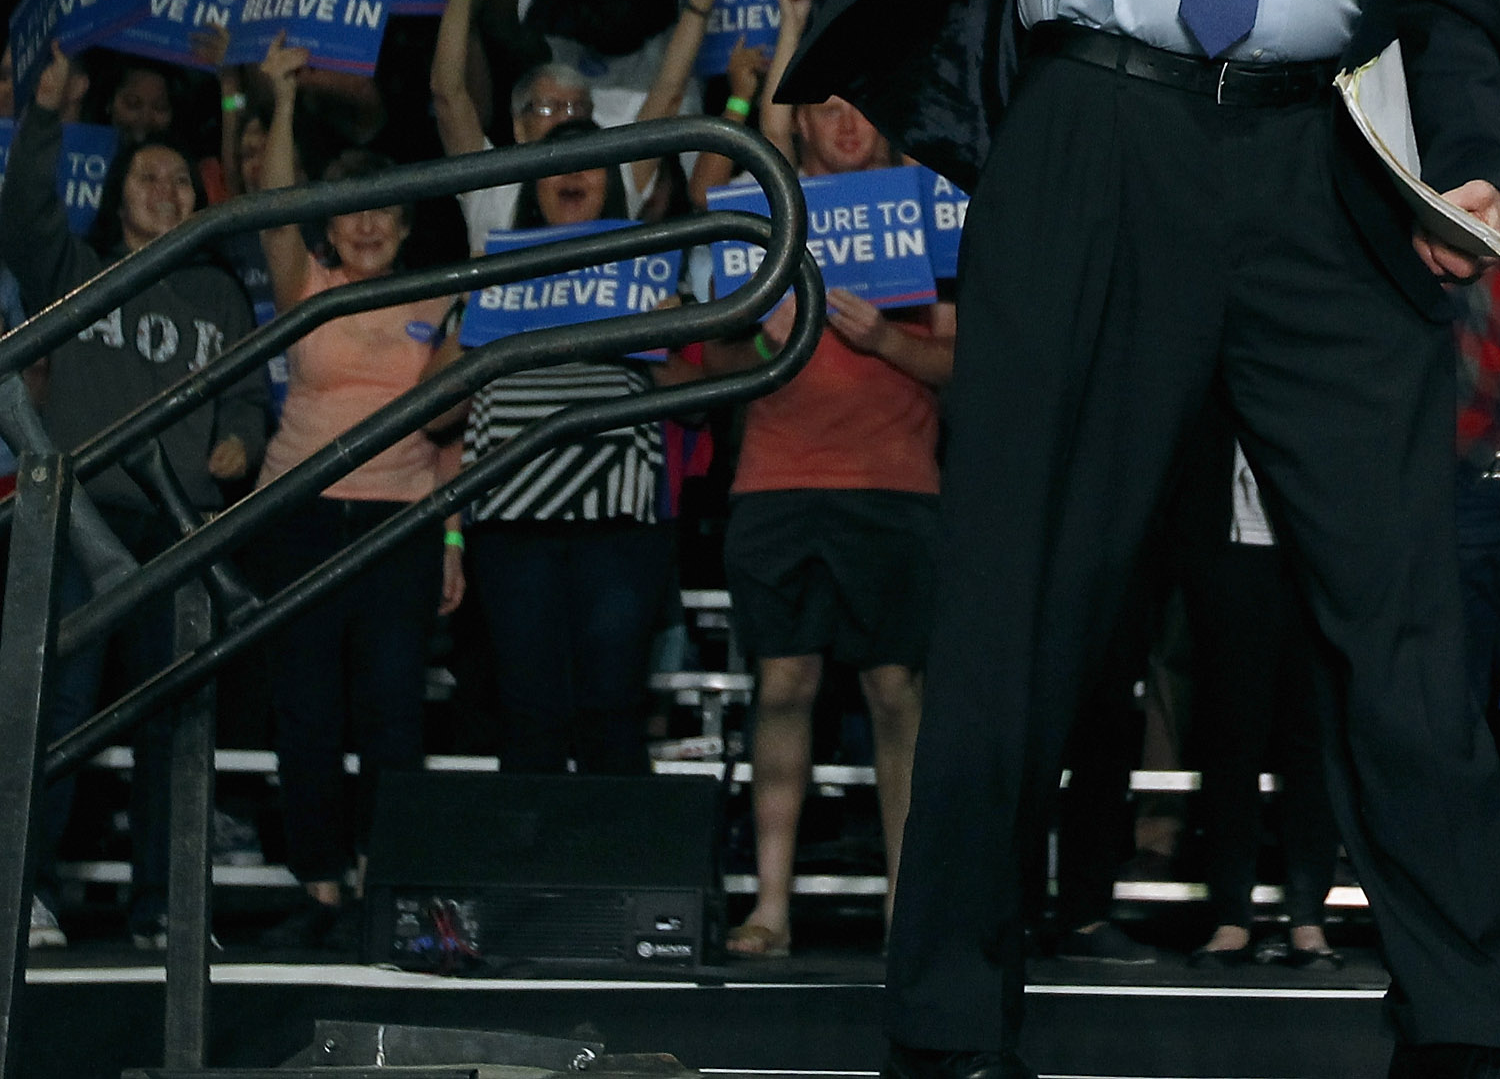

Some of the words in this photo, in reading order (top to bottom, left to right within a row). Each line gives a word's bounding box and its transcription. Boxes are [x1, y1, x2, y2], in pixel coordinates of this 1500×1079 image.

[194, 2, 230, 28] IN
[706, 4, 781, 34] ELIEV
[67, 152, 106, 180] TO
[65, 182, 103, 210] IN
[933, 174, 953, 197] A
[811, 204, 870, 235] URE
[877, 200, 921, 225] TO
[883, 229, 925, 259] IN
[633, 256, 671, 282] TO
[478, 279, 618, 311] BELIEVE
[627, 284, 667, 312] IN
